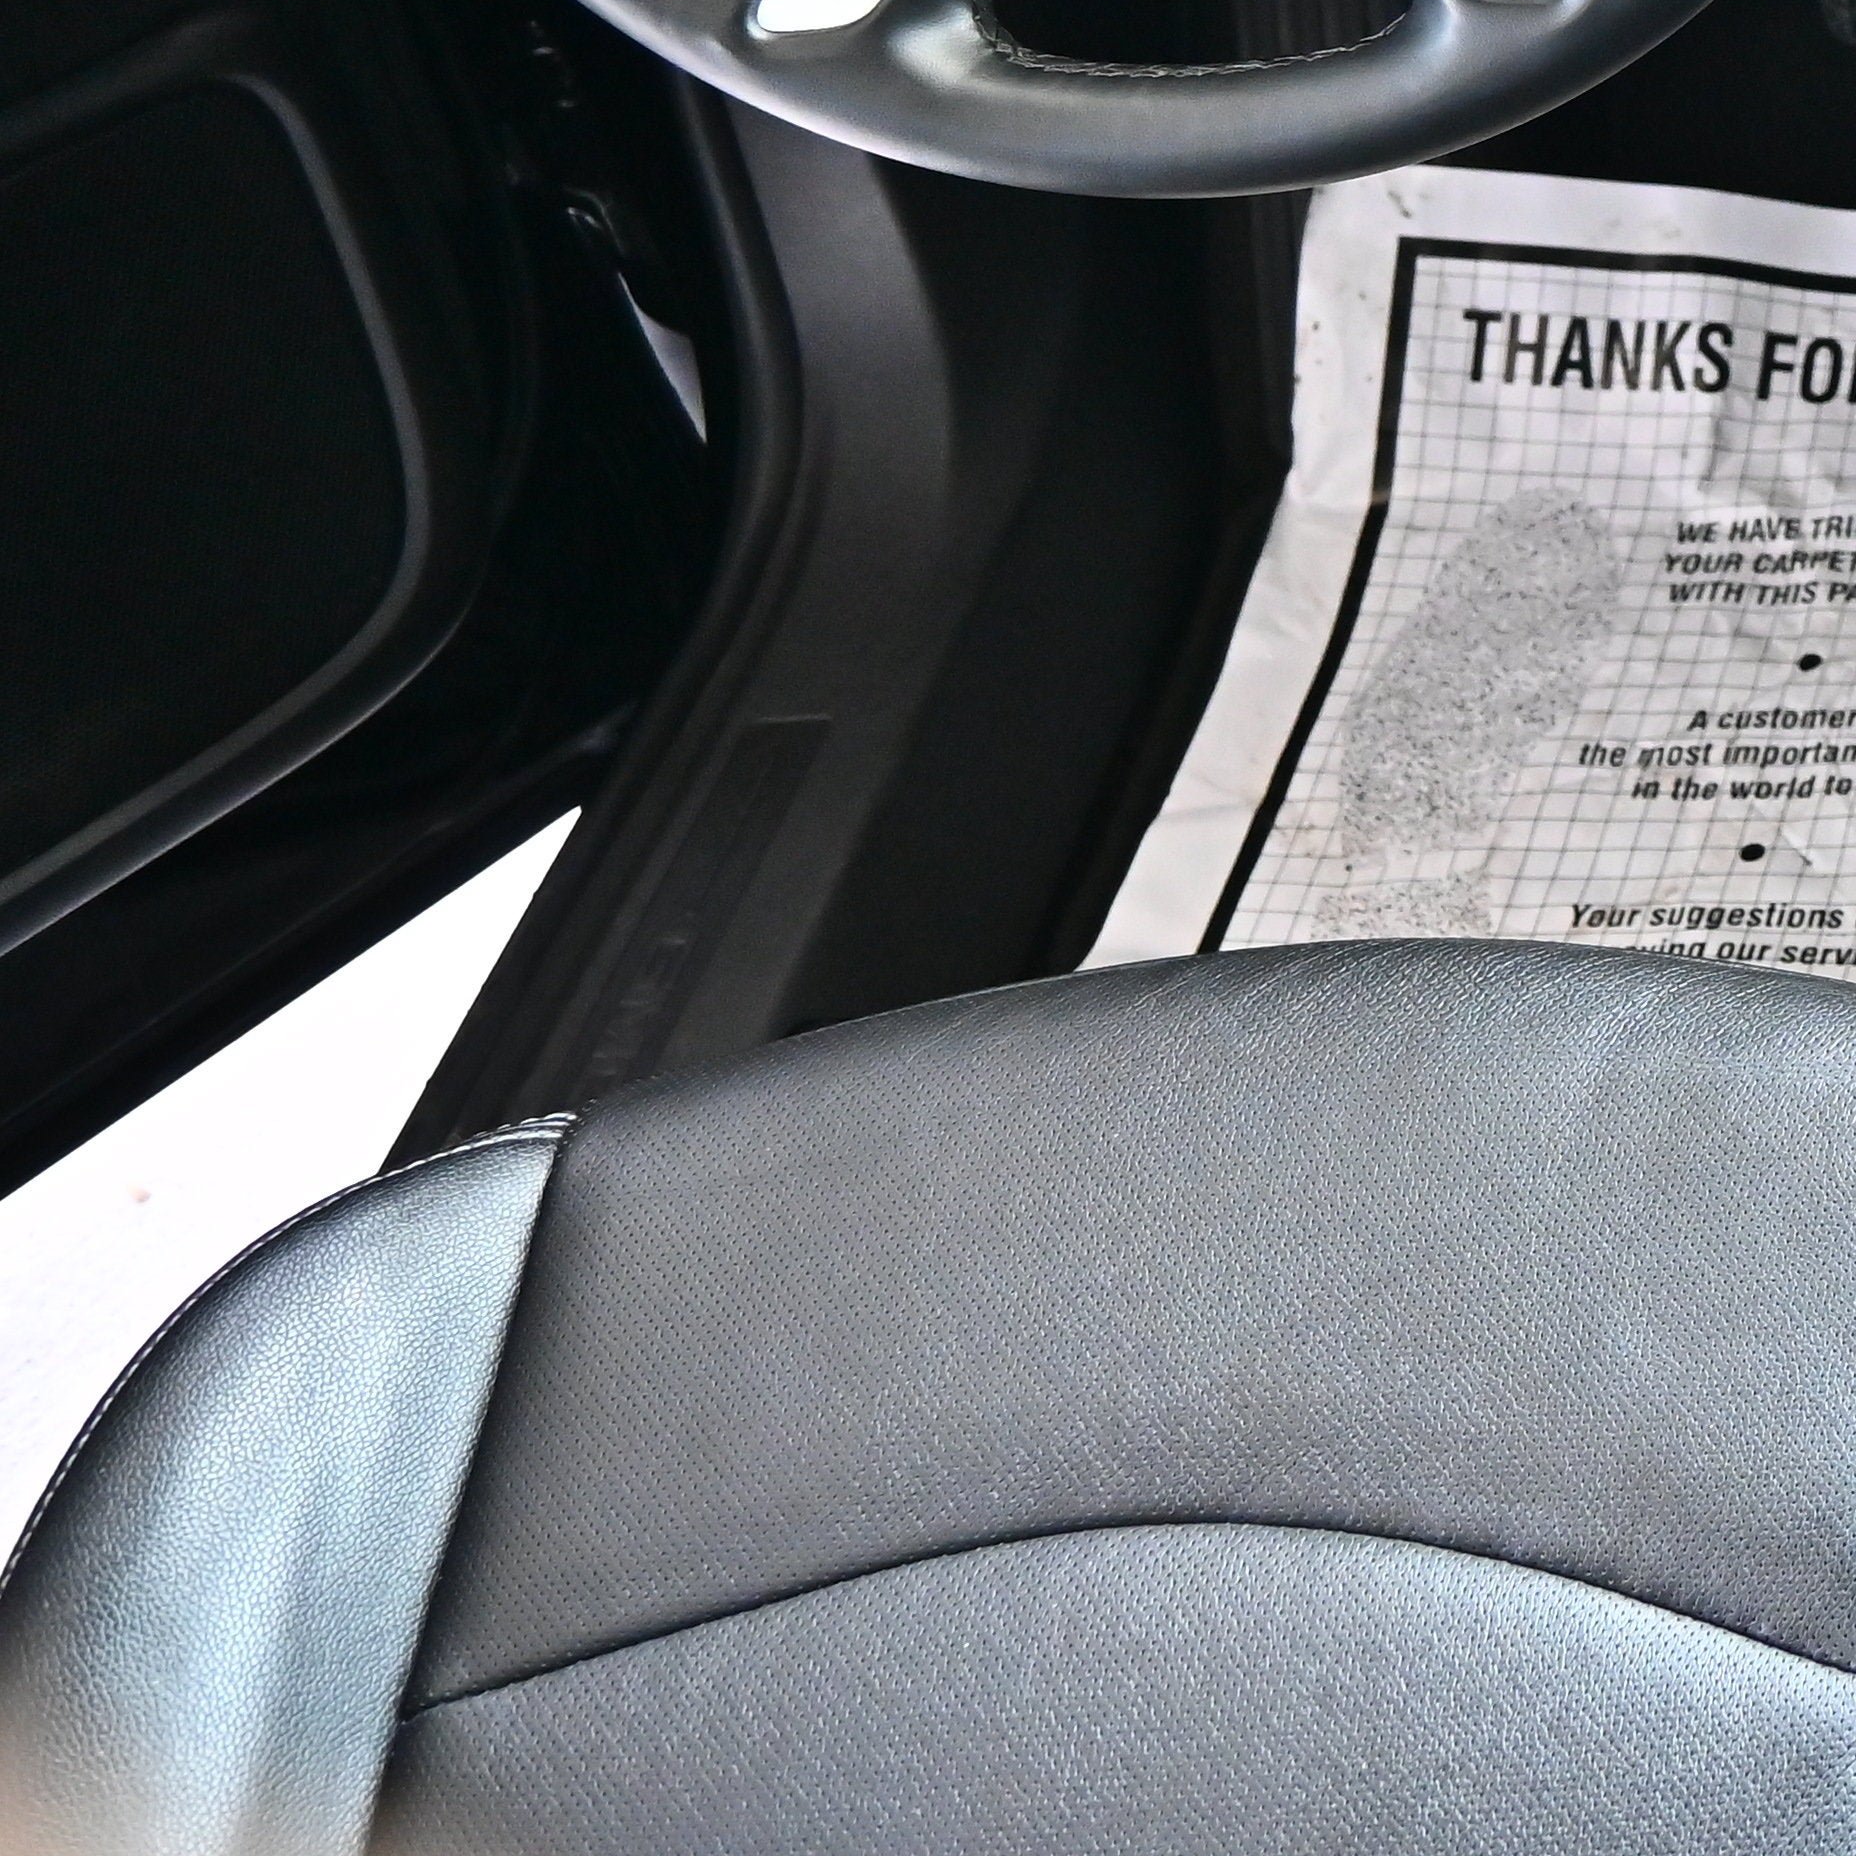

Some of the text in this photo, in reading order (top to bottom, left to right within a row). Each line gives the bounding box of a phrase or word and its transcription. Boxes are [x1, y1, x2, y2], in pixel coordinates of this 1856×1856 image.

[1464, 309, 1732, 394] THANKS
[1676, 520, 1720, 543] WE
[1664, 553, 1744, 575] YOUR
[1669, 582, 1745, 603] WITH
[1757, 582, 1816, 605] THIS
[1687, 710, 1707, 730] A
[1579, 743, 1626, 766] the
[1639, 743, 1711, 765] most
[1632, 778, 1659, 800] in
[1672, 776, 1718, 800] the
[1730, 776, 1813, 799] world
[1825, 775, 1852, 797] to
[1571, 904, 1641, 929] Your
[1649, 904, 1842, 930] suggestions
[1716, 943, 1770, 962] our
